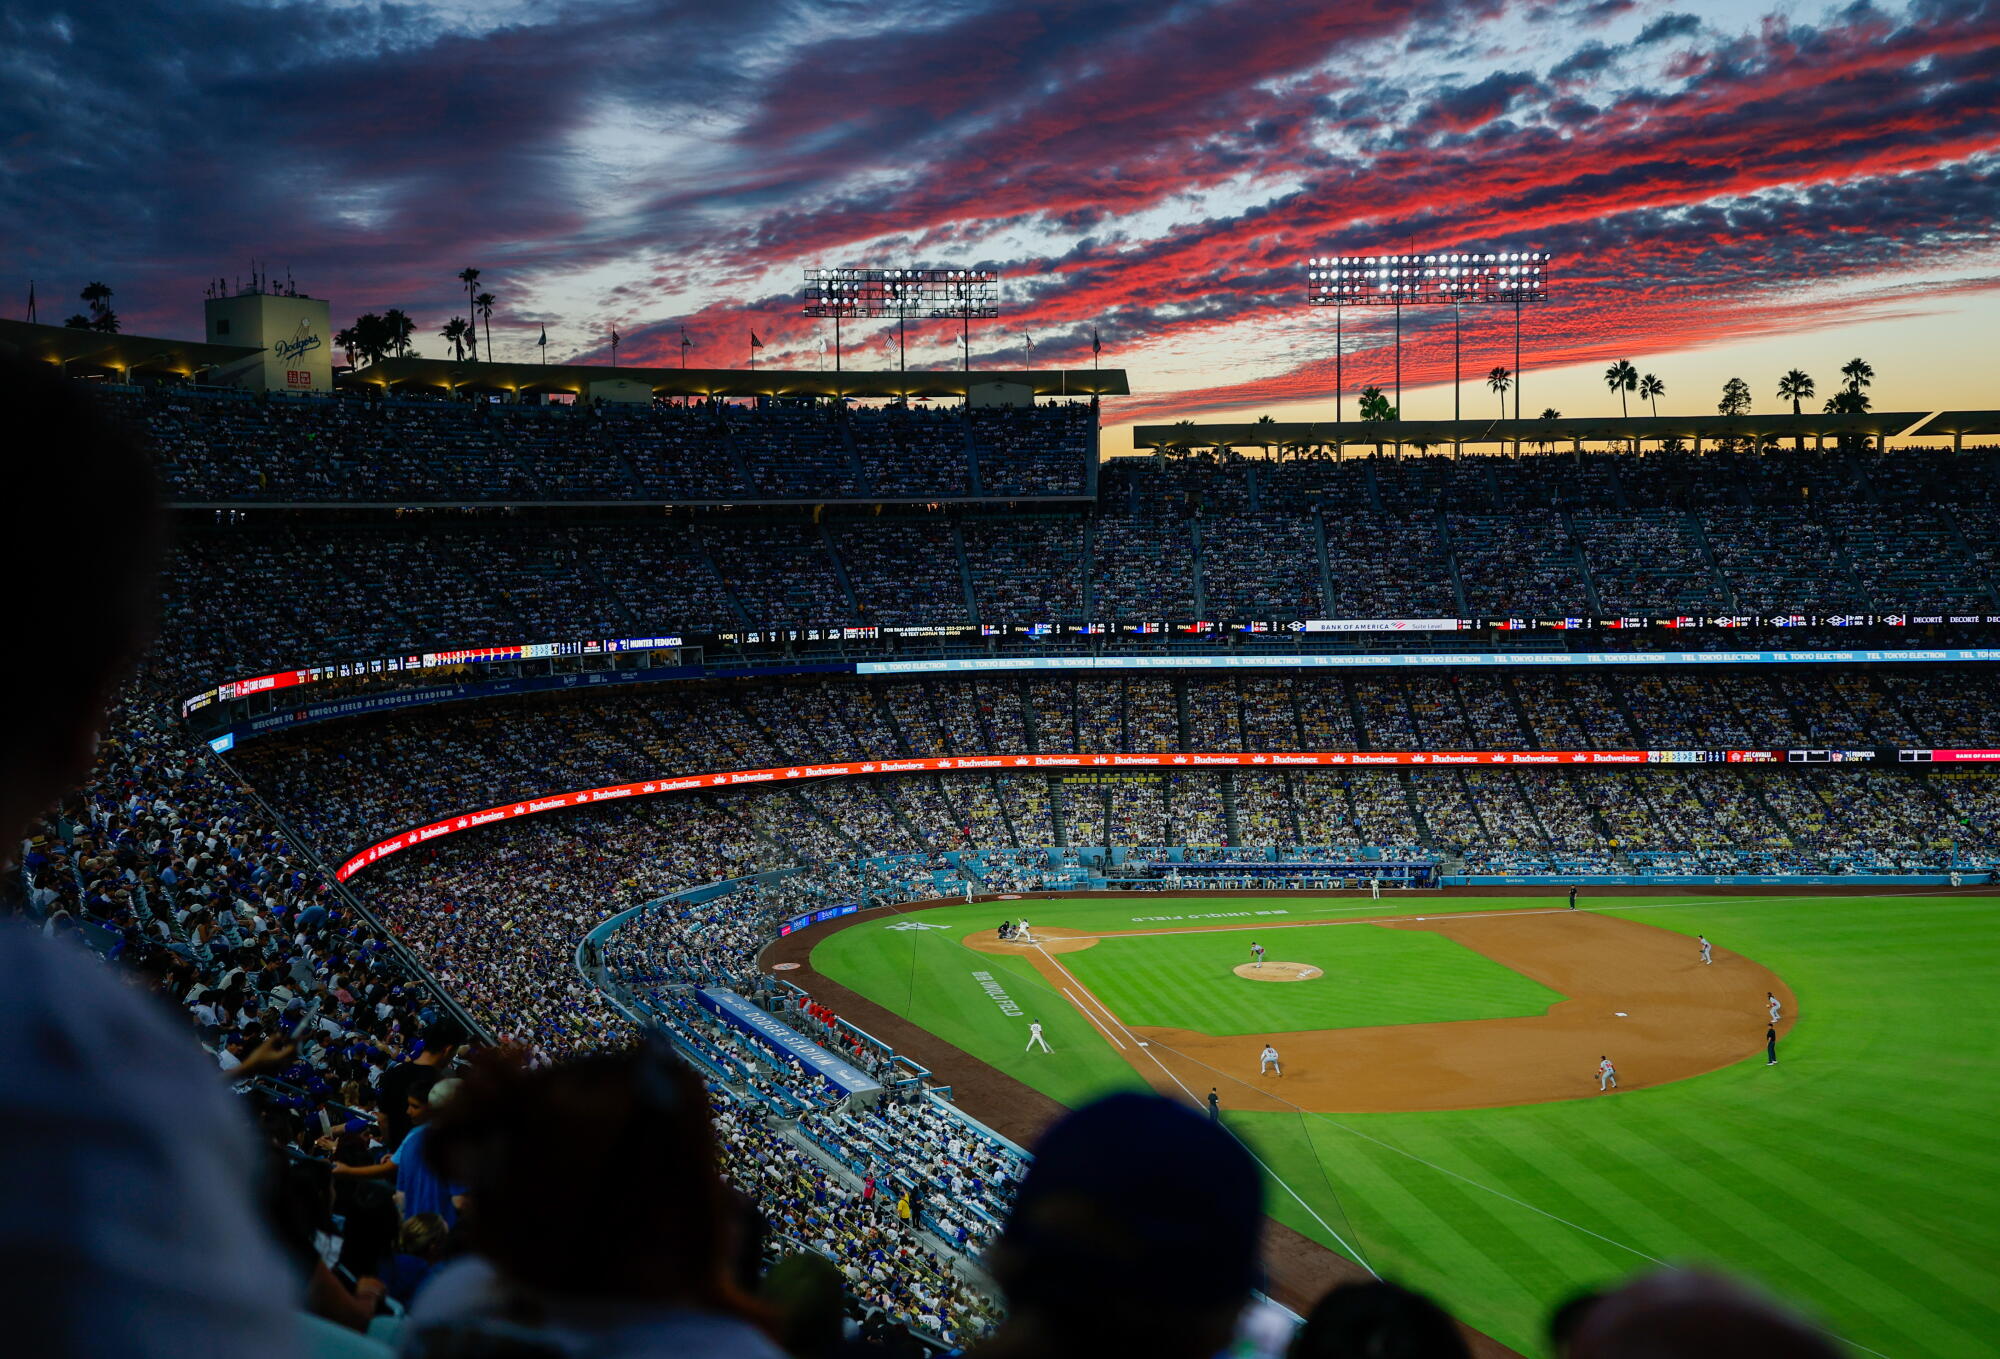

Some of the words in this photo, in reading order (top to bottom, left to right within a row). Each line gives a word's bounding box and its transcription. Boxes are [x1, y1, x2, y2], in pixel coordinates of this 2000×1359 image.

[275, 334, 320, 358] Dodgers
[630, 639, 653, 648] HUNTER
[654, 638, 682, 646] FEDUCCIA
[252, 718, 283, 730] WELCOME
[285, 714, 294, 722] TO
[309, 706, 338, 718] UNIQLO
[340, 703, 362, 712] FIELD
[378, 695, 412, 706] DODGER
[415, 689, 453, 700] STADIUM
[958, 759, 1002, 767] Budweiser
[1035, 757, 1080, 765] Budweiser
[1115, 756, 1159, 764] Budweiser
[1194, 756, 1239, 764] Budweiser
[1273, 755, 1318, 764] Budweiser
[1352, 755, 1398, 763] Budweiser
[1432, 754, 1478, 763] Budweiser
[1513, 754, 1559, 762] Budweiser
[1594, 754, 1640, 762] Budweiser
[805, 767, 848, 777] Budweiser
[881, 762, 924, 772] Budweiser
[732, 773, 774, 783] Budweiser
[660, 780, 700, 791] Budweiser
[593, 788, 631, 800] Budweiser
[530, 799, 565, 812] Budweiser
[995, 1000, 1024, 1016] FIELD
[745, 1012, 785, 1037] DODGER
[784, 1036, 836, 1066] STADIUM
